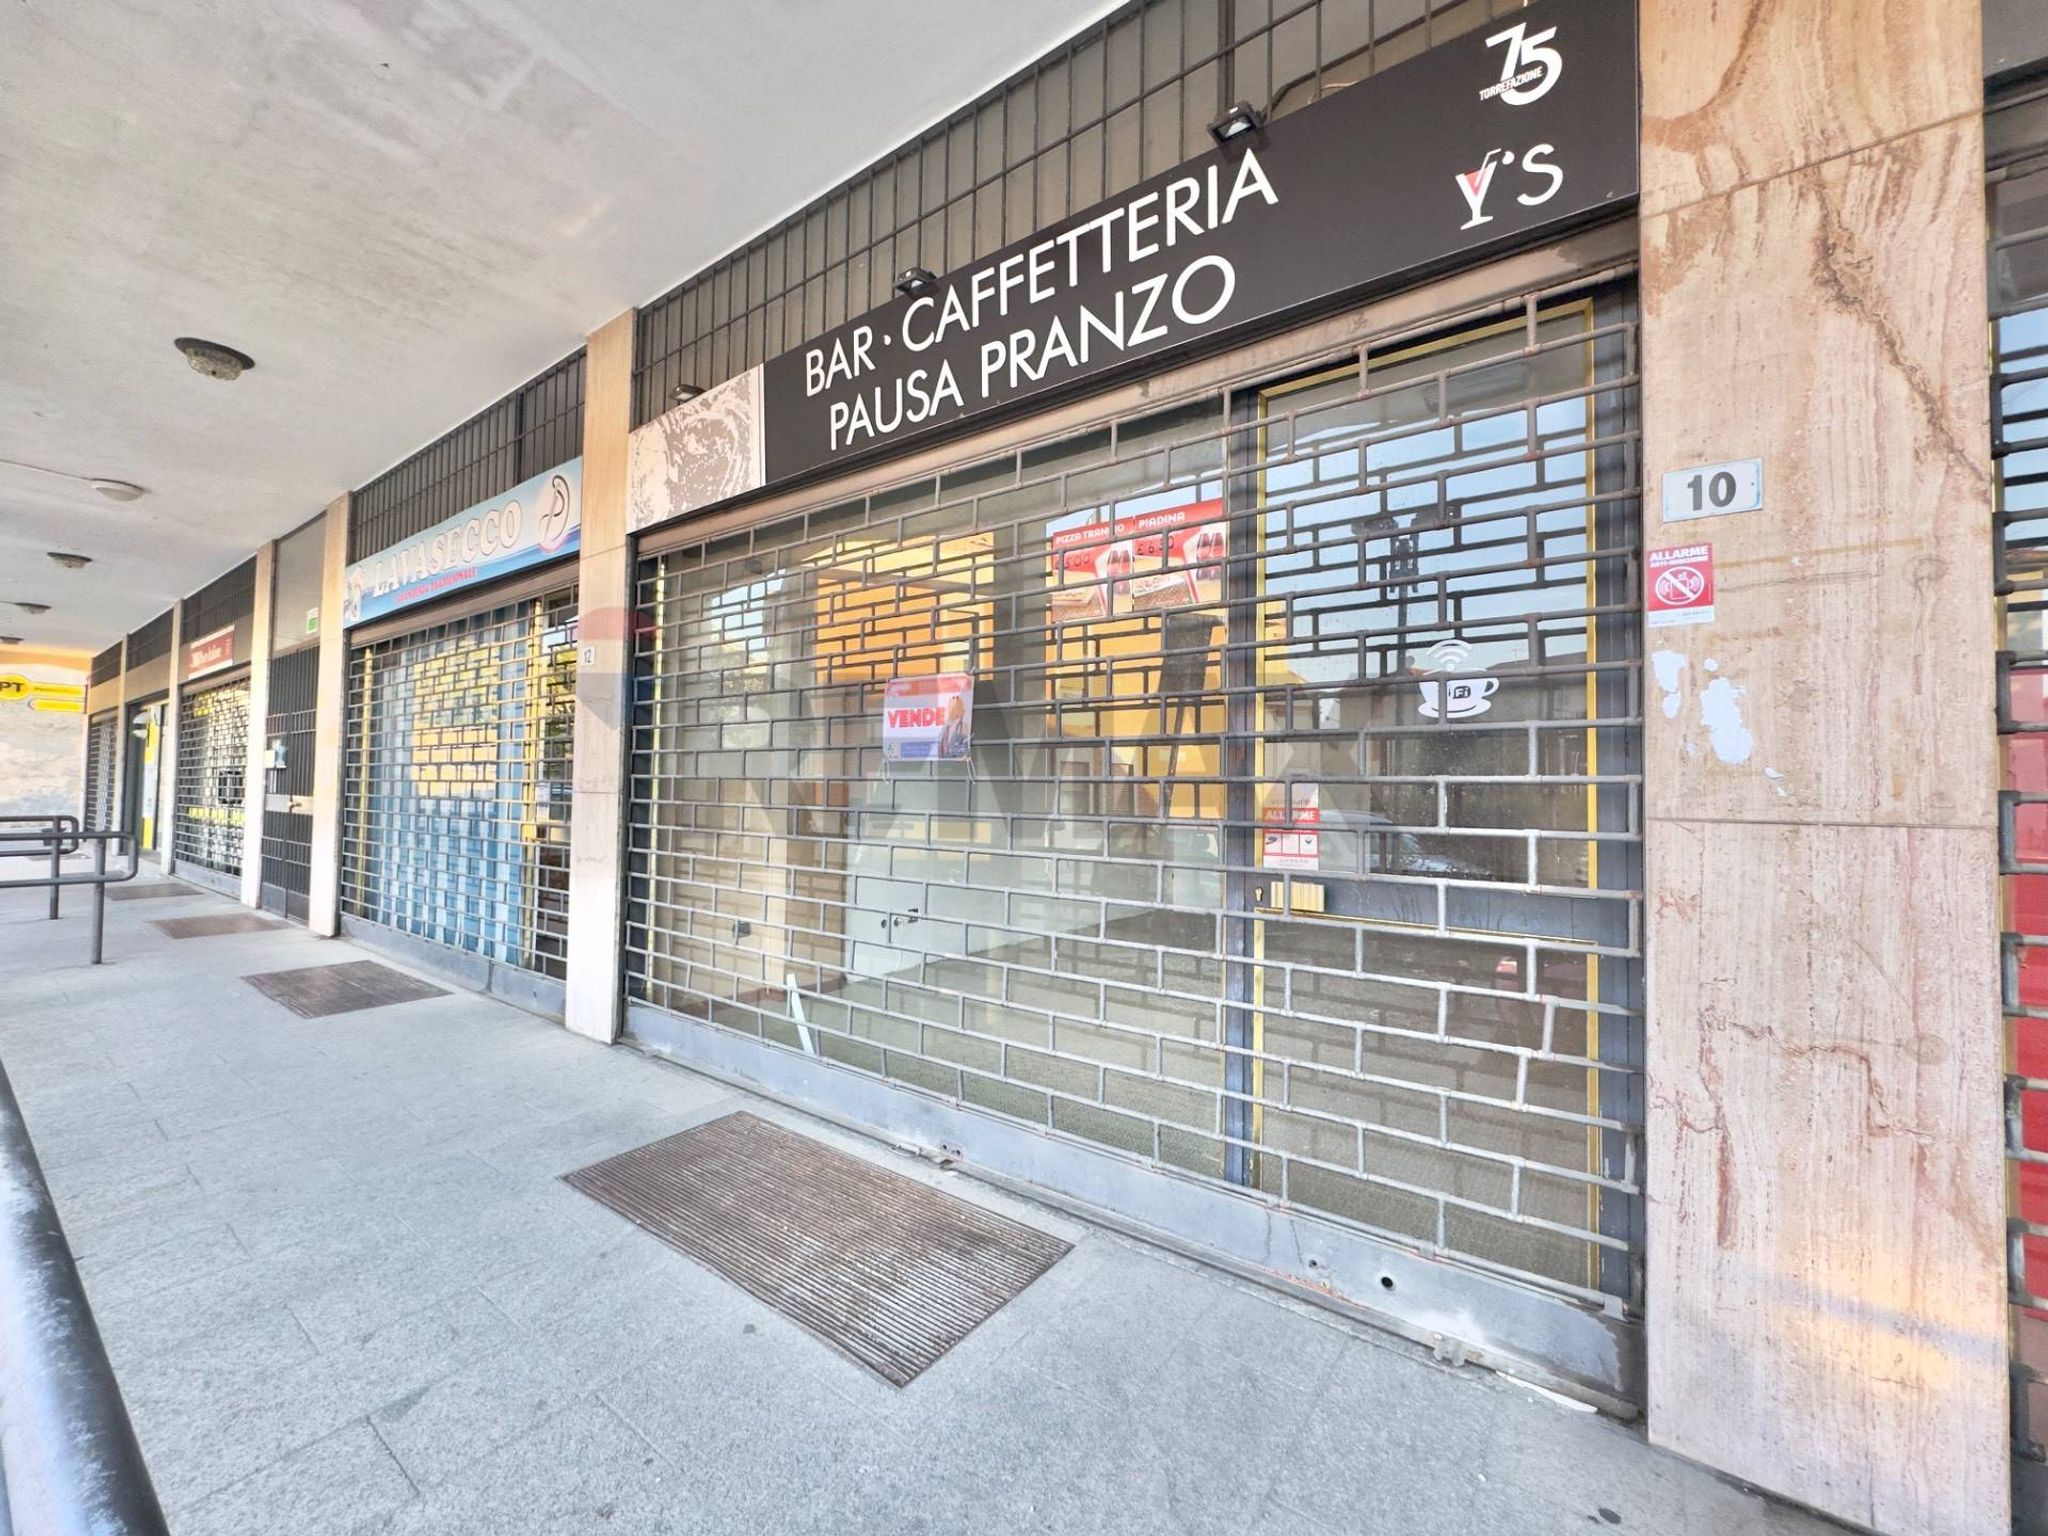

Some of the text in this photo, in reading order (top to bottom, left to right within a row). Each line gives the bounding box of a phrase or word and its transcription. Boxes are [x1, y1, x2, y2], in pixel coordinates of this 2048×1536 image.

[1485, 22, 1563, 106] 75
[1479, 66, 1544, 101] TORREFAZIONE
[805, 147, 1279, 398] BAR CAFFETTERIA
[830, 254, 1236, 451] PAUSA PRANZO
[1687, 471, 1737, 511] 10
[1056, 524, 1125, 544] PIZZA TRANIO
[1138, 511, 1185, 529] PIADINA
[372, 499, 522, 598] LAVASECCO
[1650, 545, 1709, 561] ALLARME
[583, 649, 592, 664] 12
[1266, 809, 1316, 821] ALLRME
